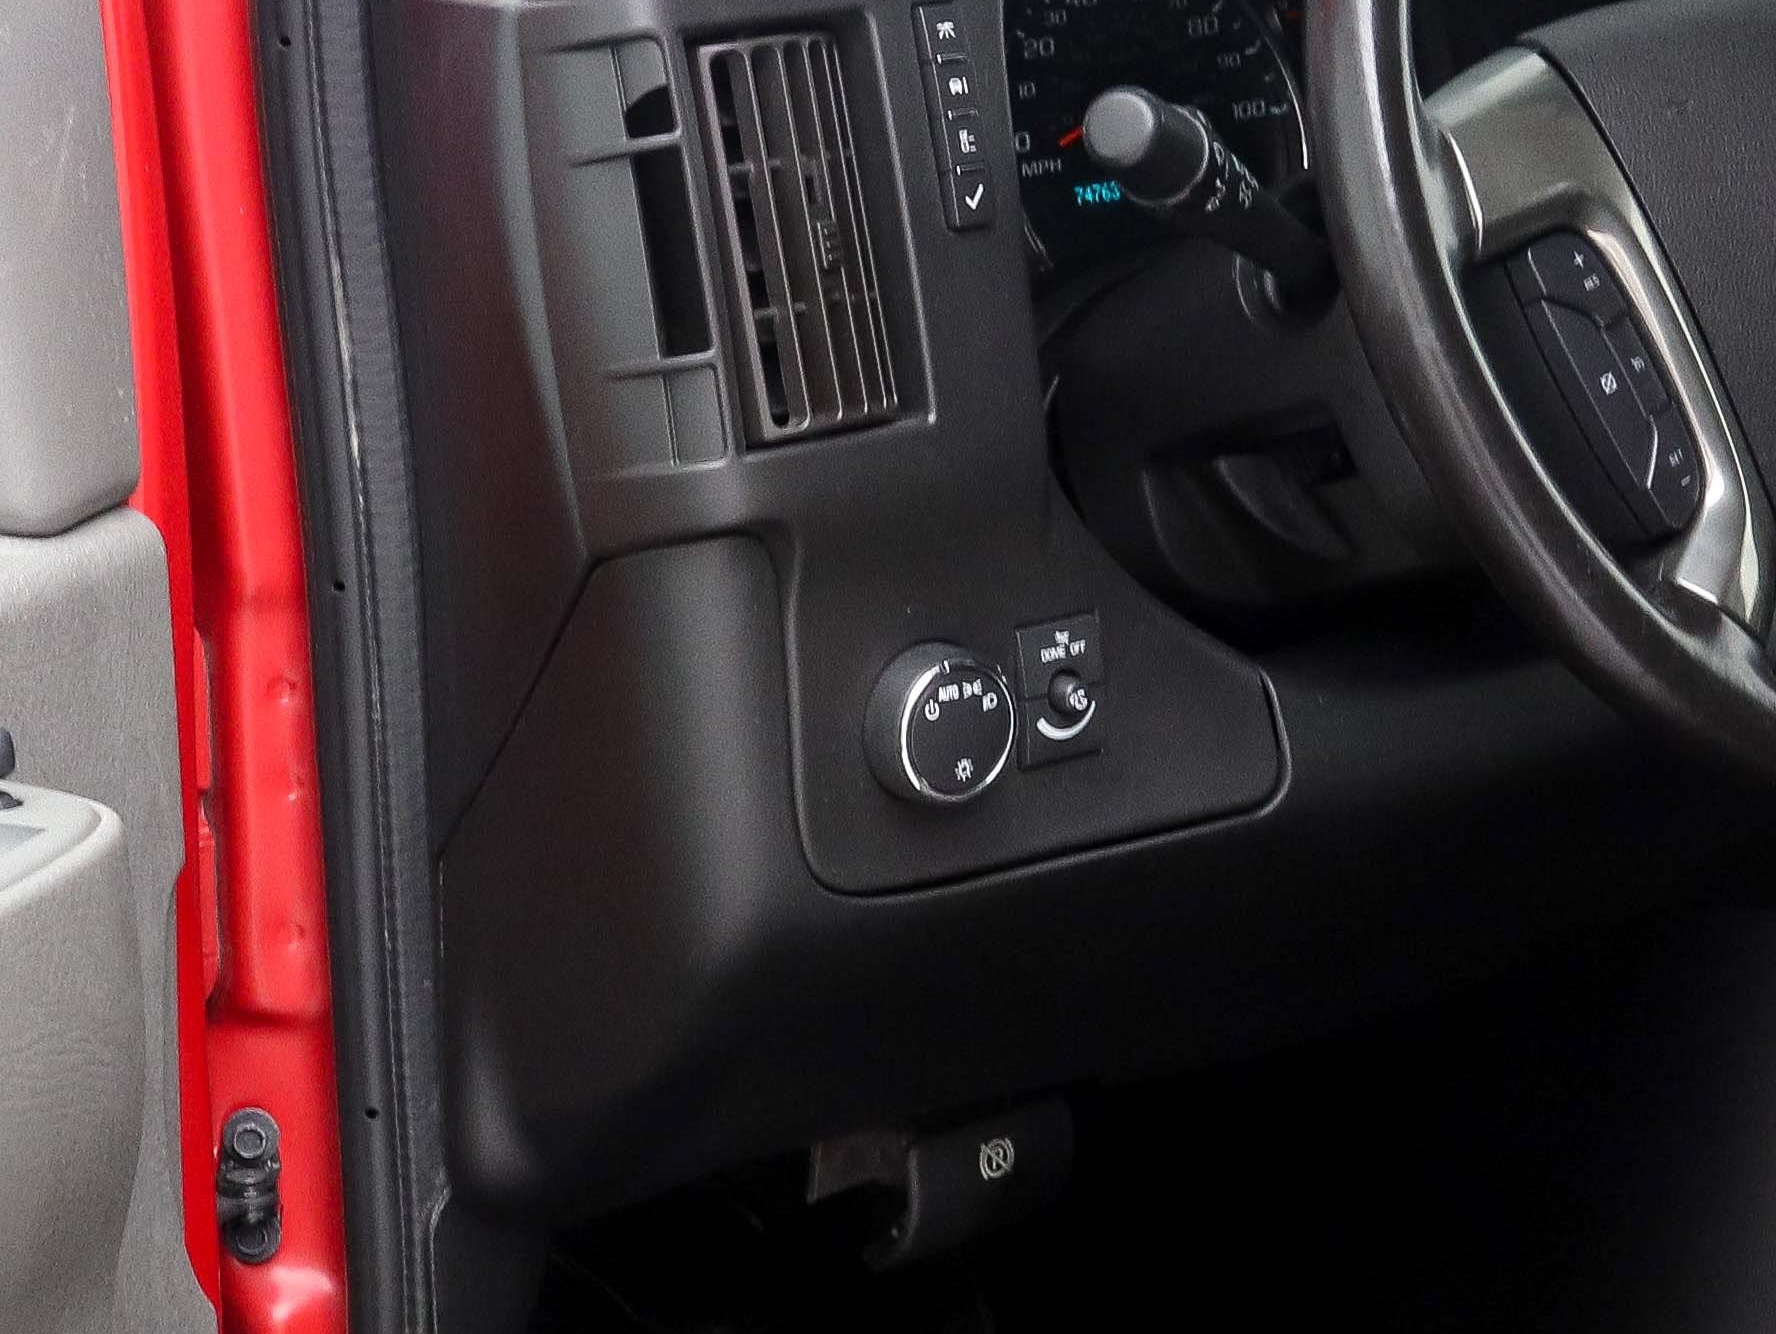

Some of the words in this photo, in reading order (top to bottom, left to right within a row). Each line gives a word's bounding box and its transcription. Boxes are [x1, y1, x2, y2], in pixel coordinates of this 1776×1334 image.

[1024, 37, 1055, 60] 20
[1015, 131, 1031, 154] 0
[1022, 157, 1062, 178] MPH
[1040, 643, 1066, 663] DOME
[1069, 639, 1086, 656] OFF
[938, 683, 960, 703] AUTO
